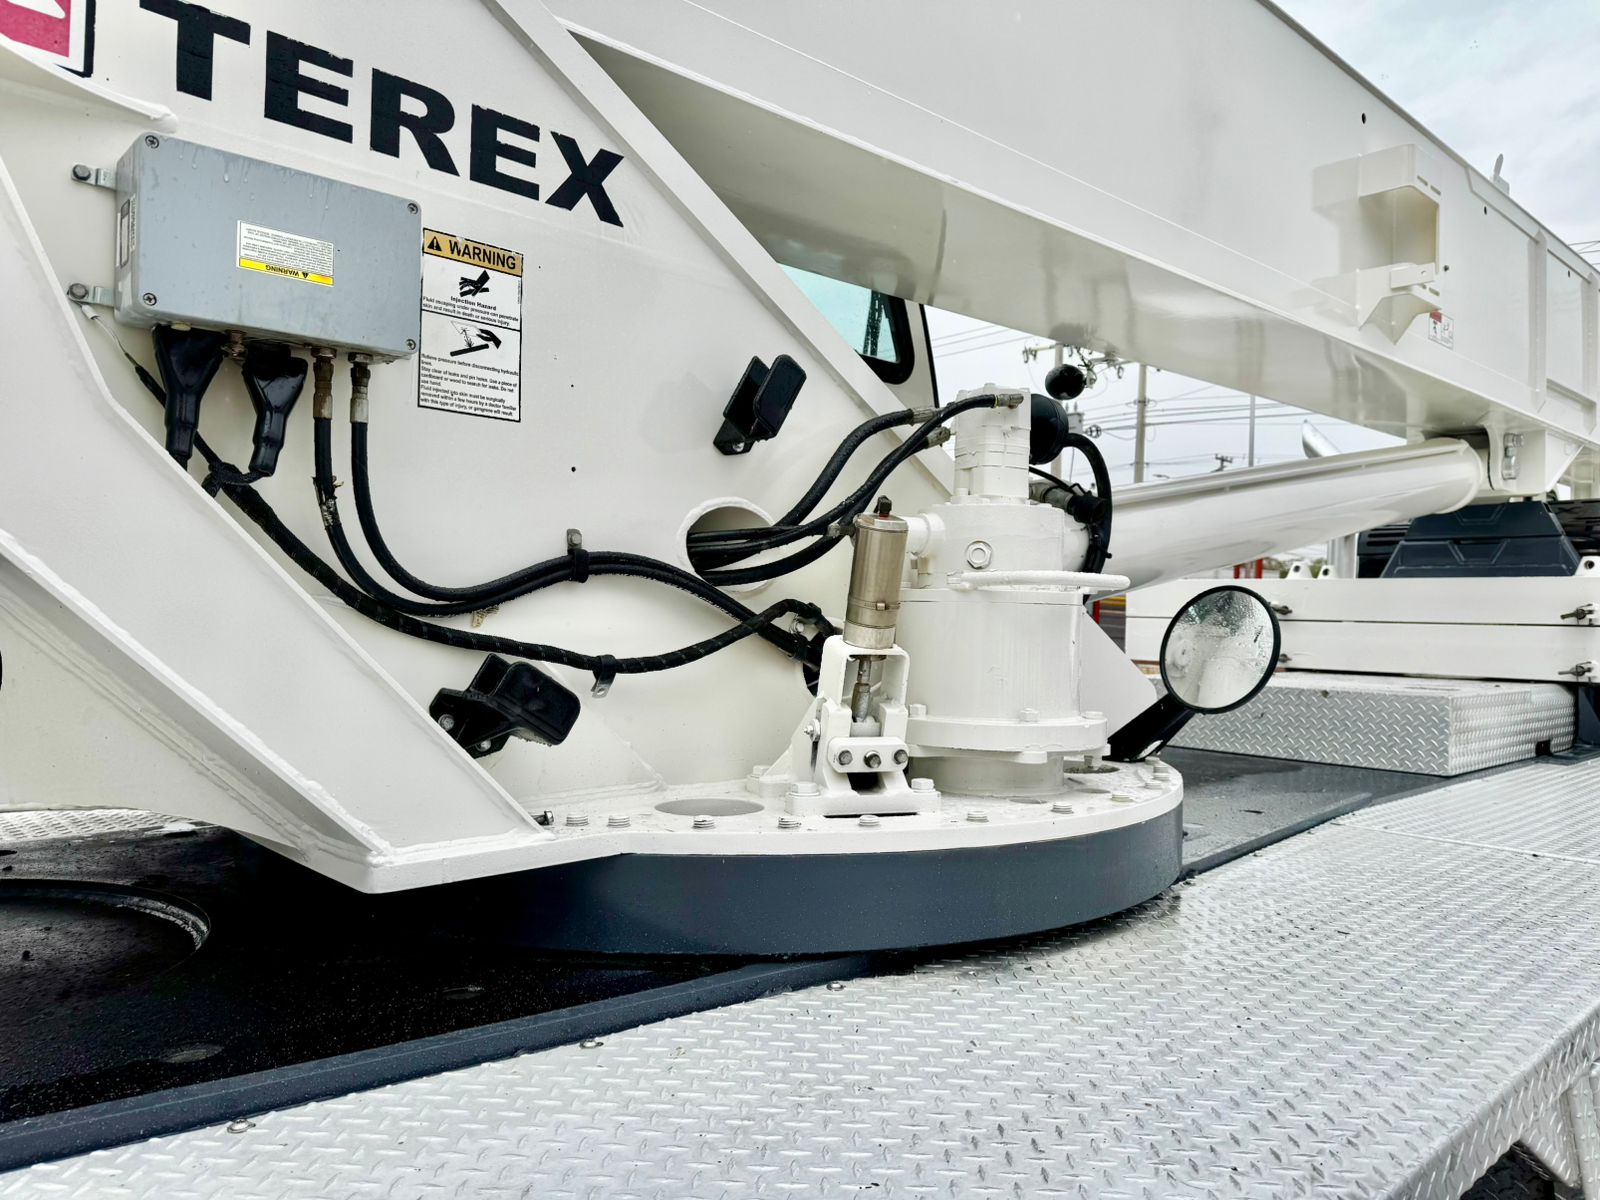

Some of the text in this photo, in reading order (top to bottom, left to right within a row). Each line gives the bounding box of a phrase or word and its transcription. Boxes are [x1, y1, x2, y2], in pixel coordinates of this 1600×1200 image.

[138, 0, 625, 228] TEREX
[449, 239, 516, 270] WARNING
[265, 264, 300, 277] WARNING
[450, 295, 496, 310] Injection Hazard
[470, 307, 489, 316] pressure
[498, 313, 518, 322] penetrate
[471, 363, 500, 373] disconnecting
[500, 368, 518, 376] hydraulic
[485, 395, 505, 404] surgically
